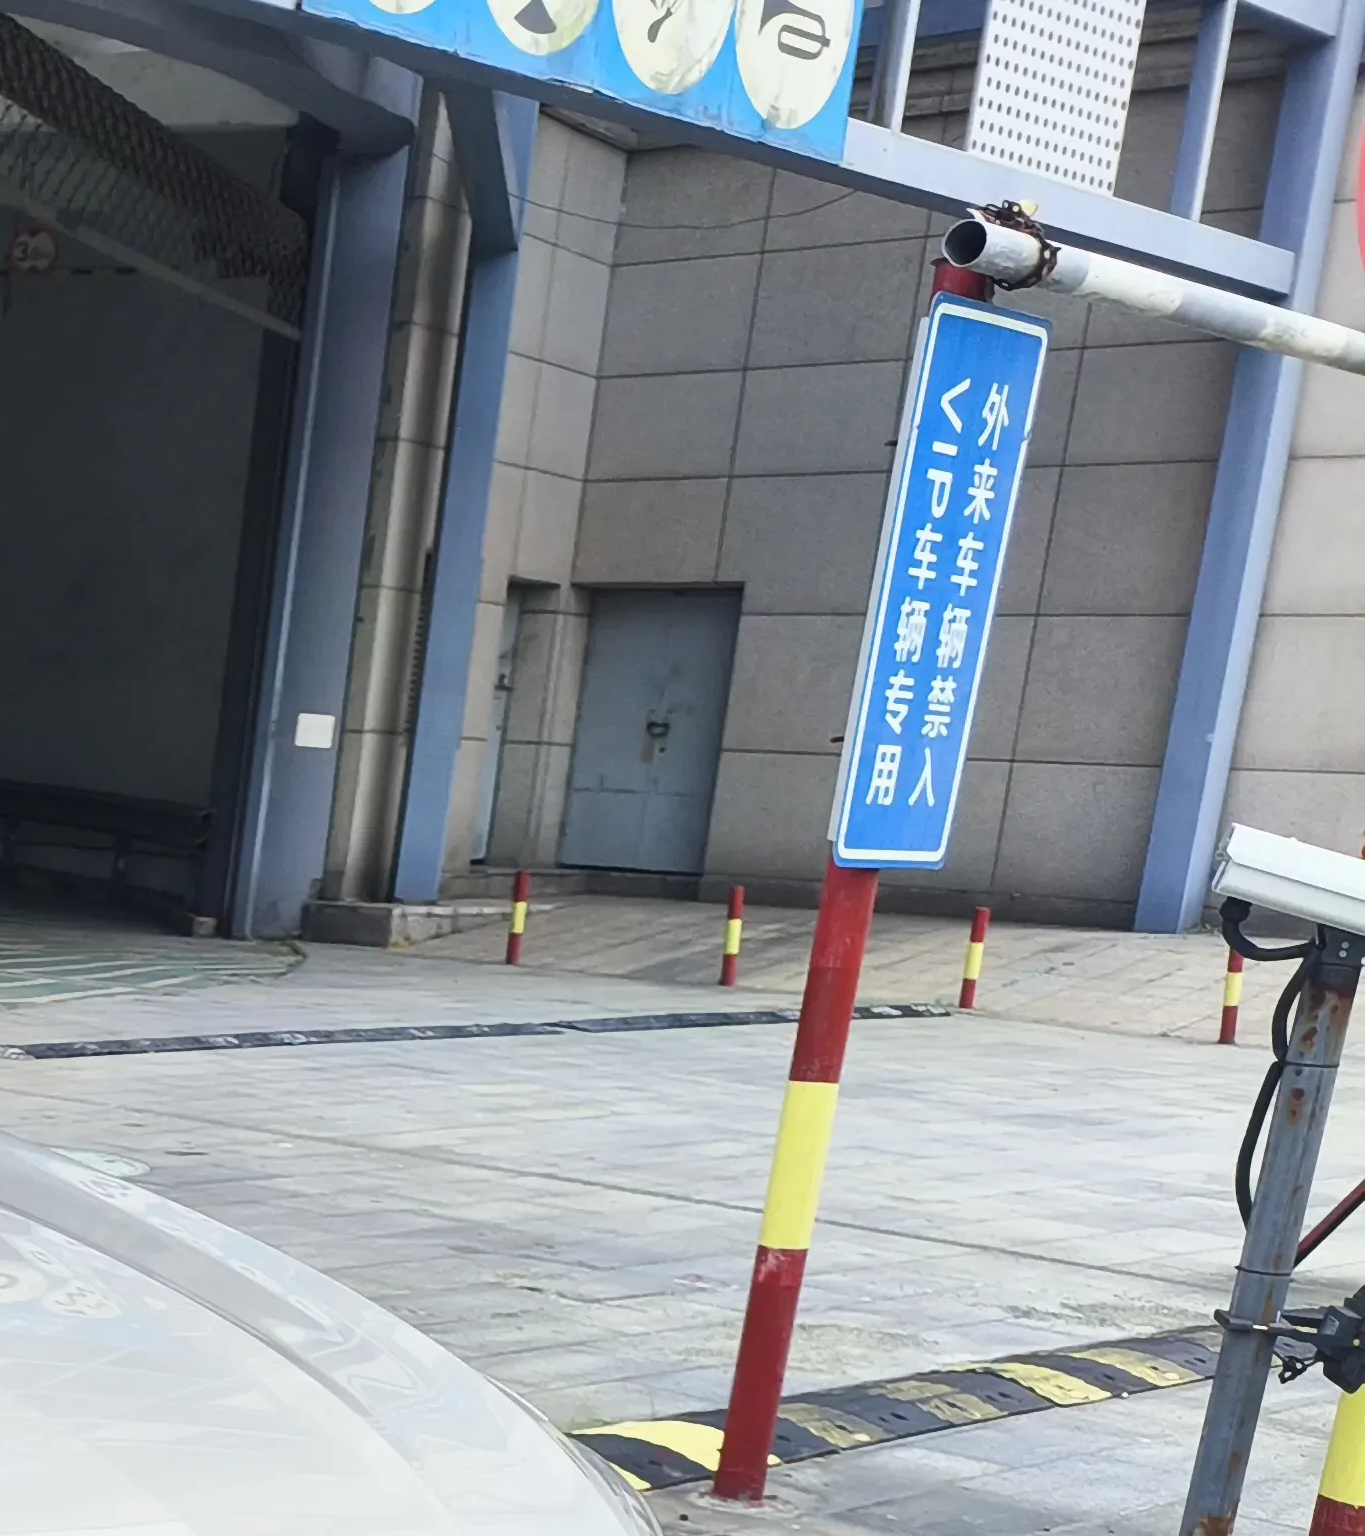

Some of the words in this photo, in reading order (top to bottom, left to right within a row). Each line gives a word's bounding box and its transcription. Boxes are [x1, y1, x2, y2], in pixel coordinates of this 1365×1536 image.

[907, 381, 1010, 808] 外来车辆禁入
